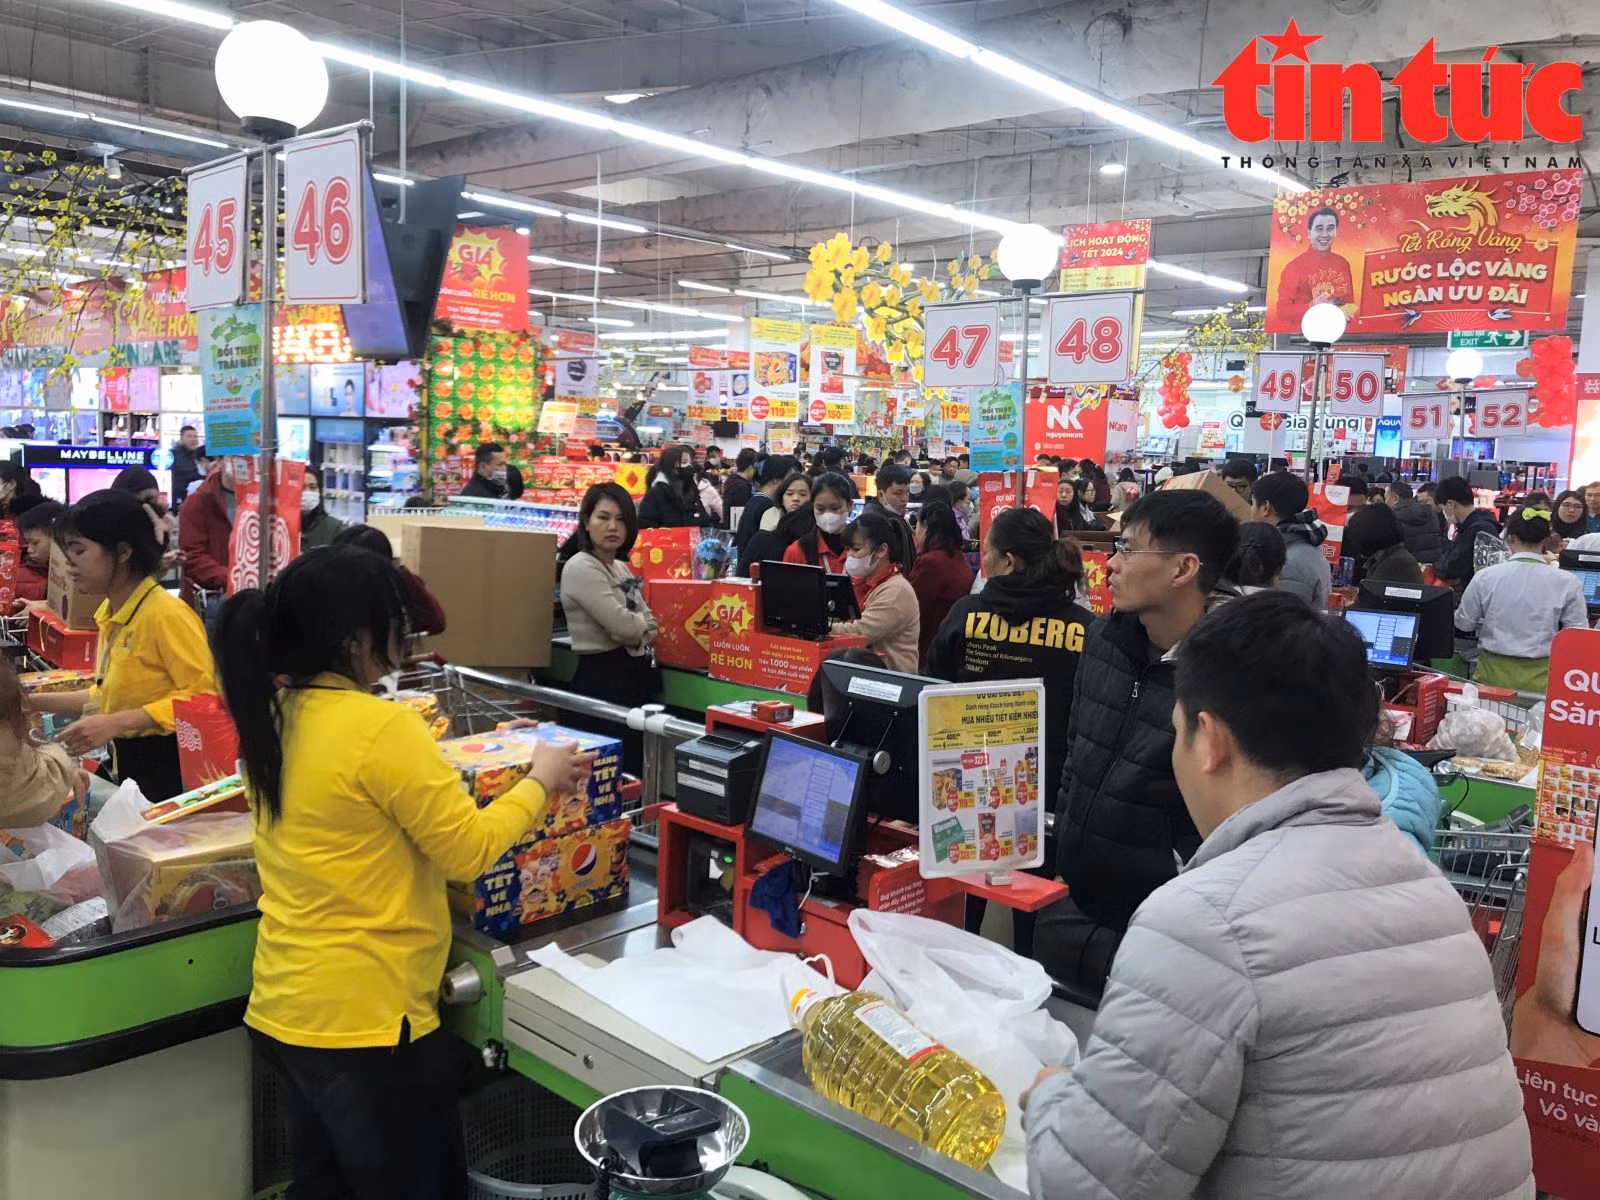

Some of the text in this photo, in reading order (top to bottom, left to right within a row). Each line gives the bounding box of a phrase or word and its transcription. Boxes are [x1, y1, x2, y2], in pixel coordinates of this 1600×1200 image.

[291, 176, 353, 266] 46
[192, 198, 238, 275] 45
[1088, 235, 1115, 247] HOẠT
[1116, 232, 1146, 246] ĐỘNG
[1399, 231, 1422, 253] Tết
[1477, 226, 1523, 254] Vàng
[1082, 246, 1124, 258] TẾT 2024
[1370, 257, 1548, 287] RƯỚC LỘC VÀNG
[1383, 283, 1529, 308] NGÀN ƯU ĐÃI
[931, 325, 991, 370] 47
[1055, 316, 1122, 364] 48
[1461, 338, 1480, 346] EXIT
[1259, 370, 1297, 401] 49
[1334, 370, 1379, 404] 50
[770, 407, 785, 417] 119
[941, 404, 958, 419] 119
[1046, 405, 1084, 430] NK
[1377, 419, 1401, 427] AQUA
[1410, 405, 1443, 428] 51
[1482, 402, 1522, 428] 52
[60, 449, 145, 460] MAYBELLINE
[717, 603, 745, 626] GIÁ
[964, 611, 1085, 653] IZOBERG
[713, 640, 750, 652] LUÔN LUÔN
[710, 650, 753, 670] RẺ HƠN
[770, 658, 789, 669] 1.000
[961, 715, 975, 725] MUA
[994, 710, 1008, 722] TIẾT
[1562, 1082, 1598, 1107] tục
[1539, 1098, 1568, 1121] Vô
[1574, 1113, 1600, 1134] và
